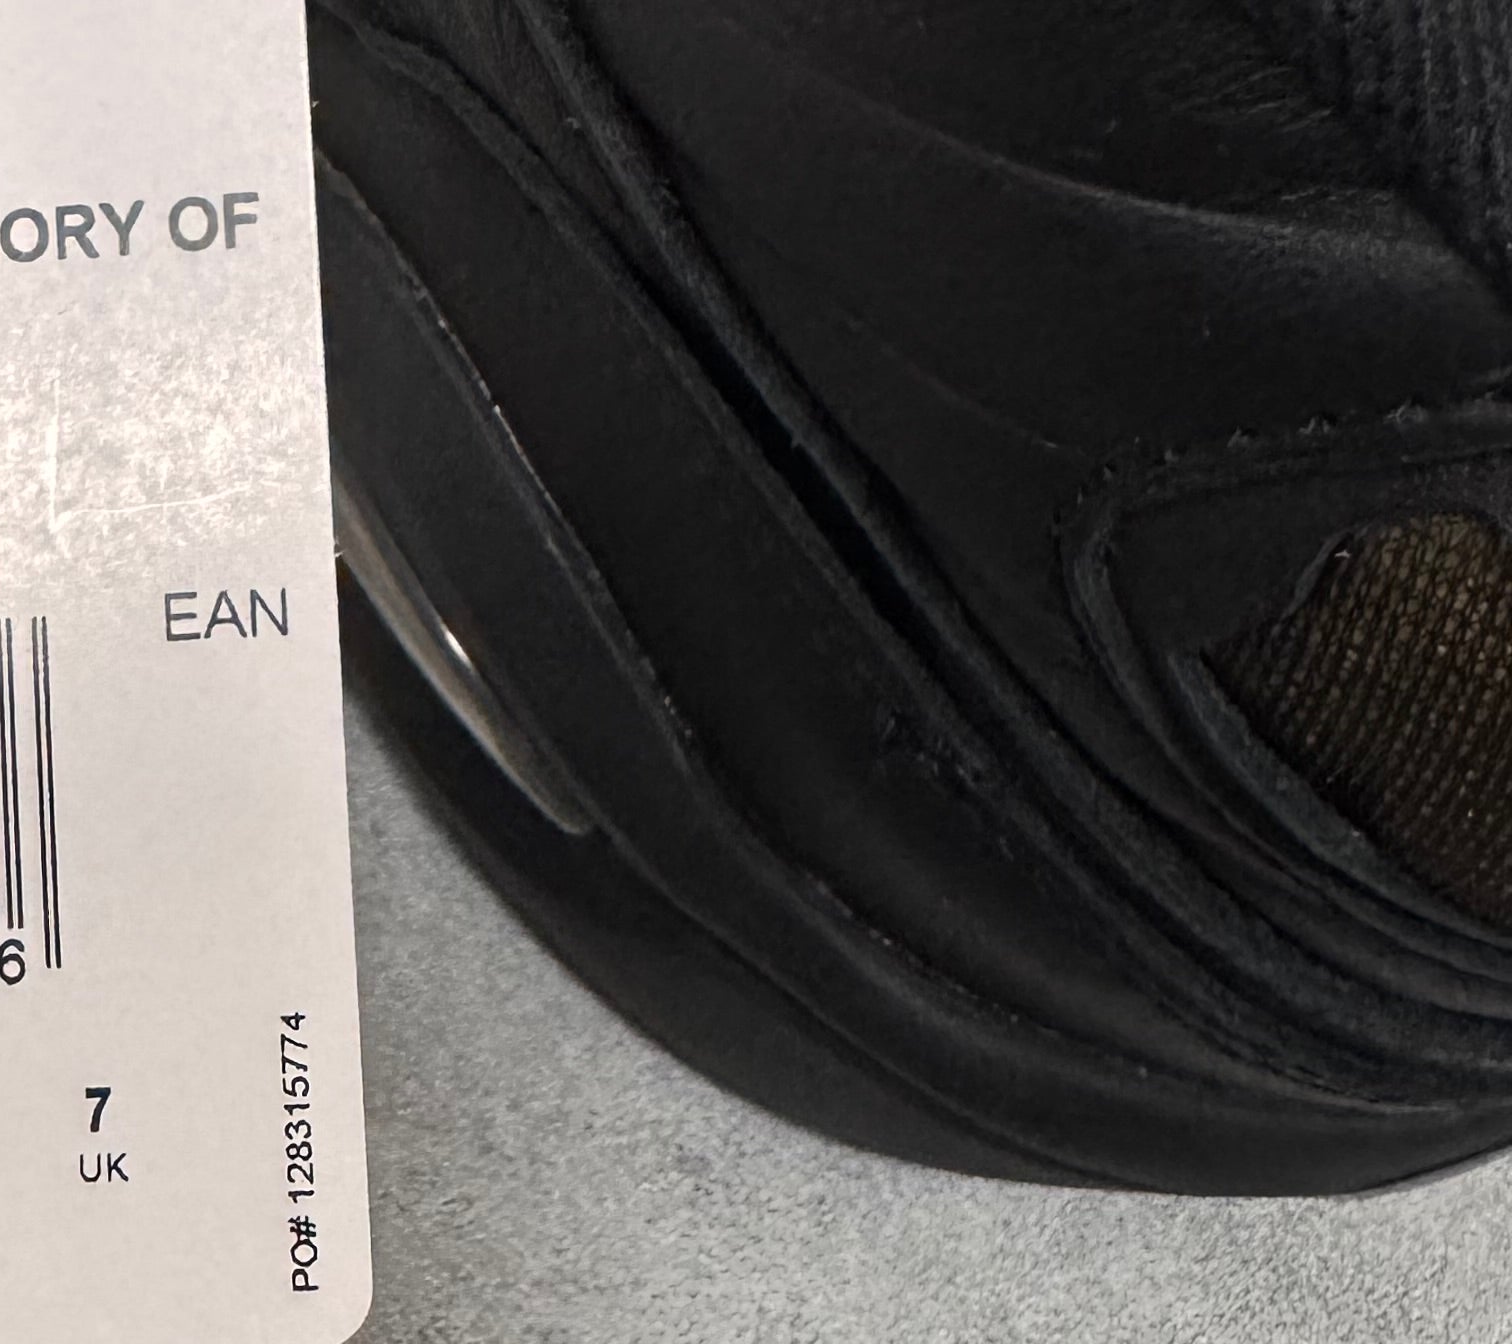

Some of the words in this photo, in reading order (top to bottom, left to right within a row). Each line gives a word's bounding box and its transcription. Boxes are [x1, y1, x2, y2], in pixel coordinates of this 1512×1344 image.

[167, 191, 260, 253] OF
[163, 586, 289, 643] EAN
[84, 1086, 112, 1134] 7
[279, 1011, 316, 1205] 128315774
[79, 1152, 130, 1184] UK
[286, 1214, 320, 1293] PO#
